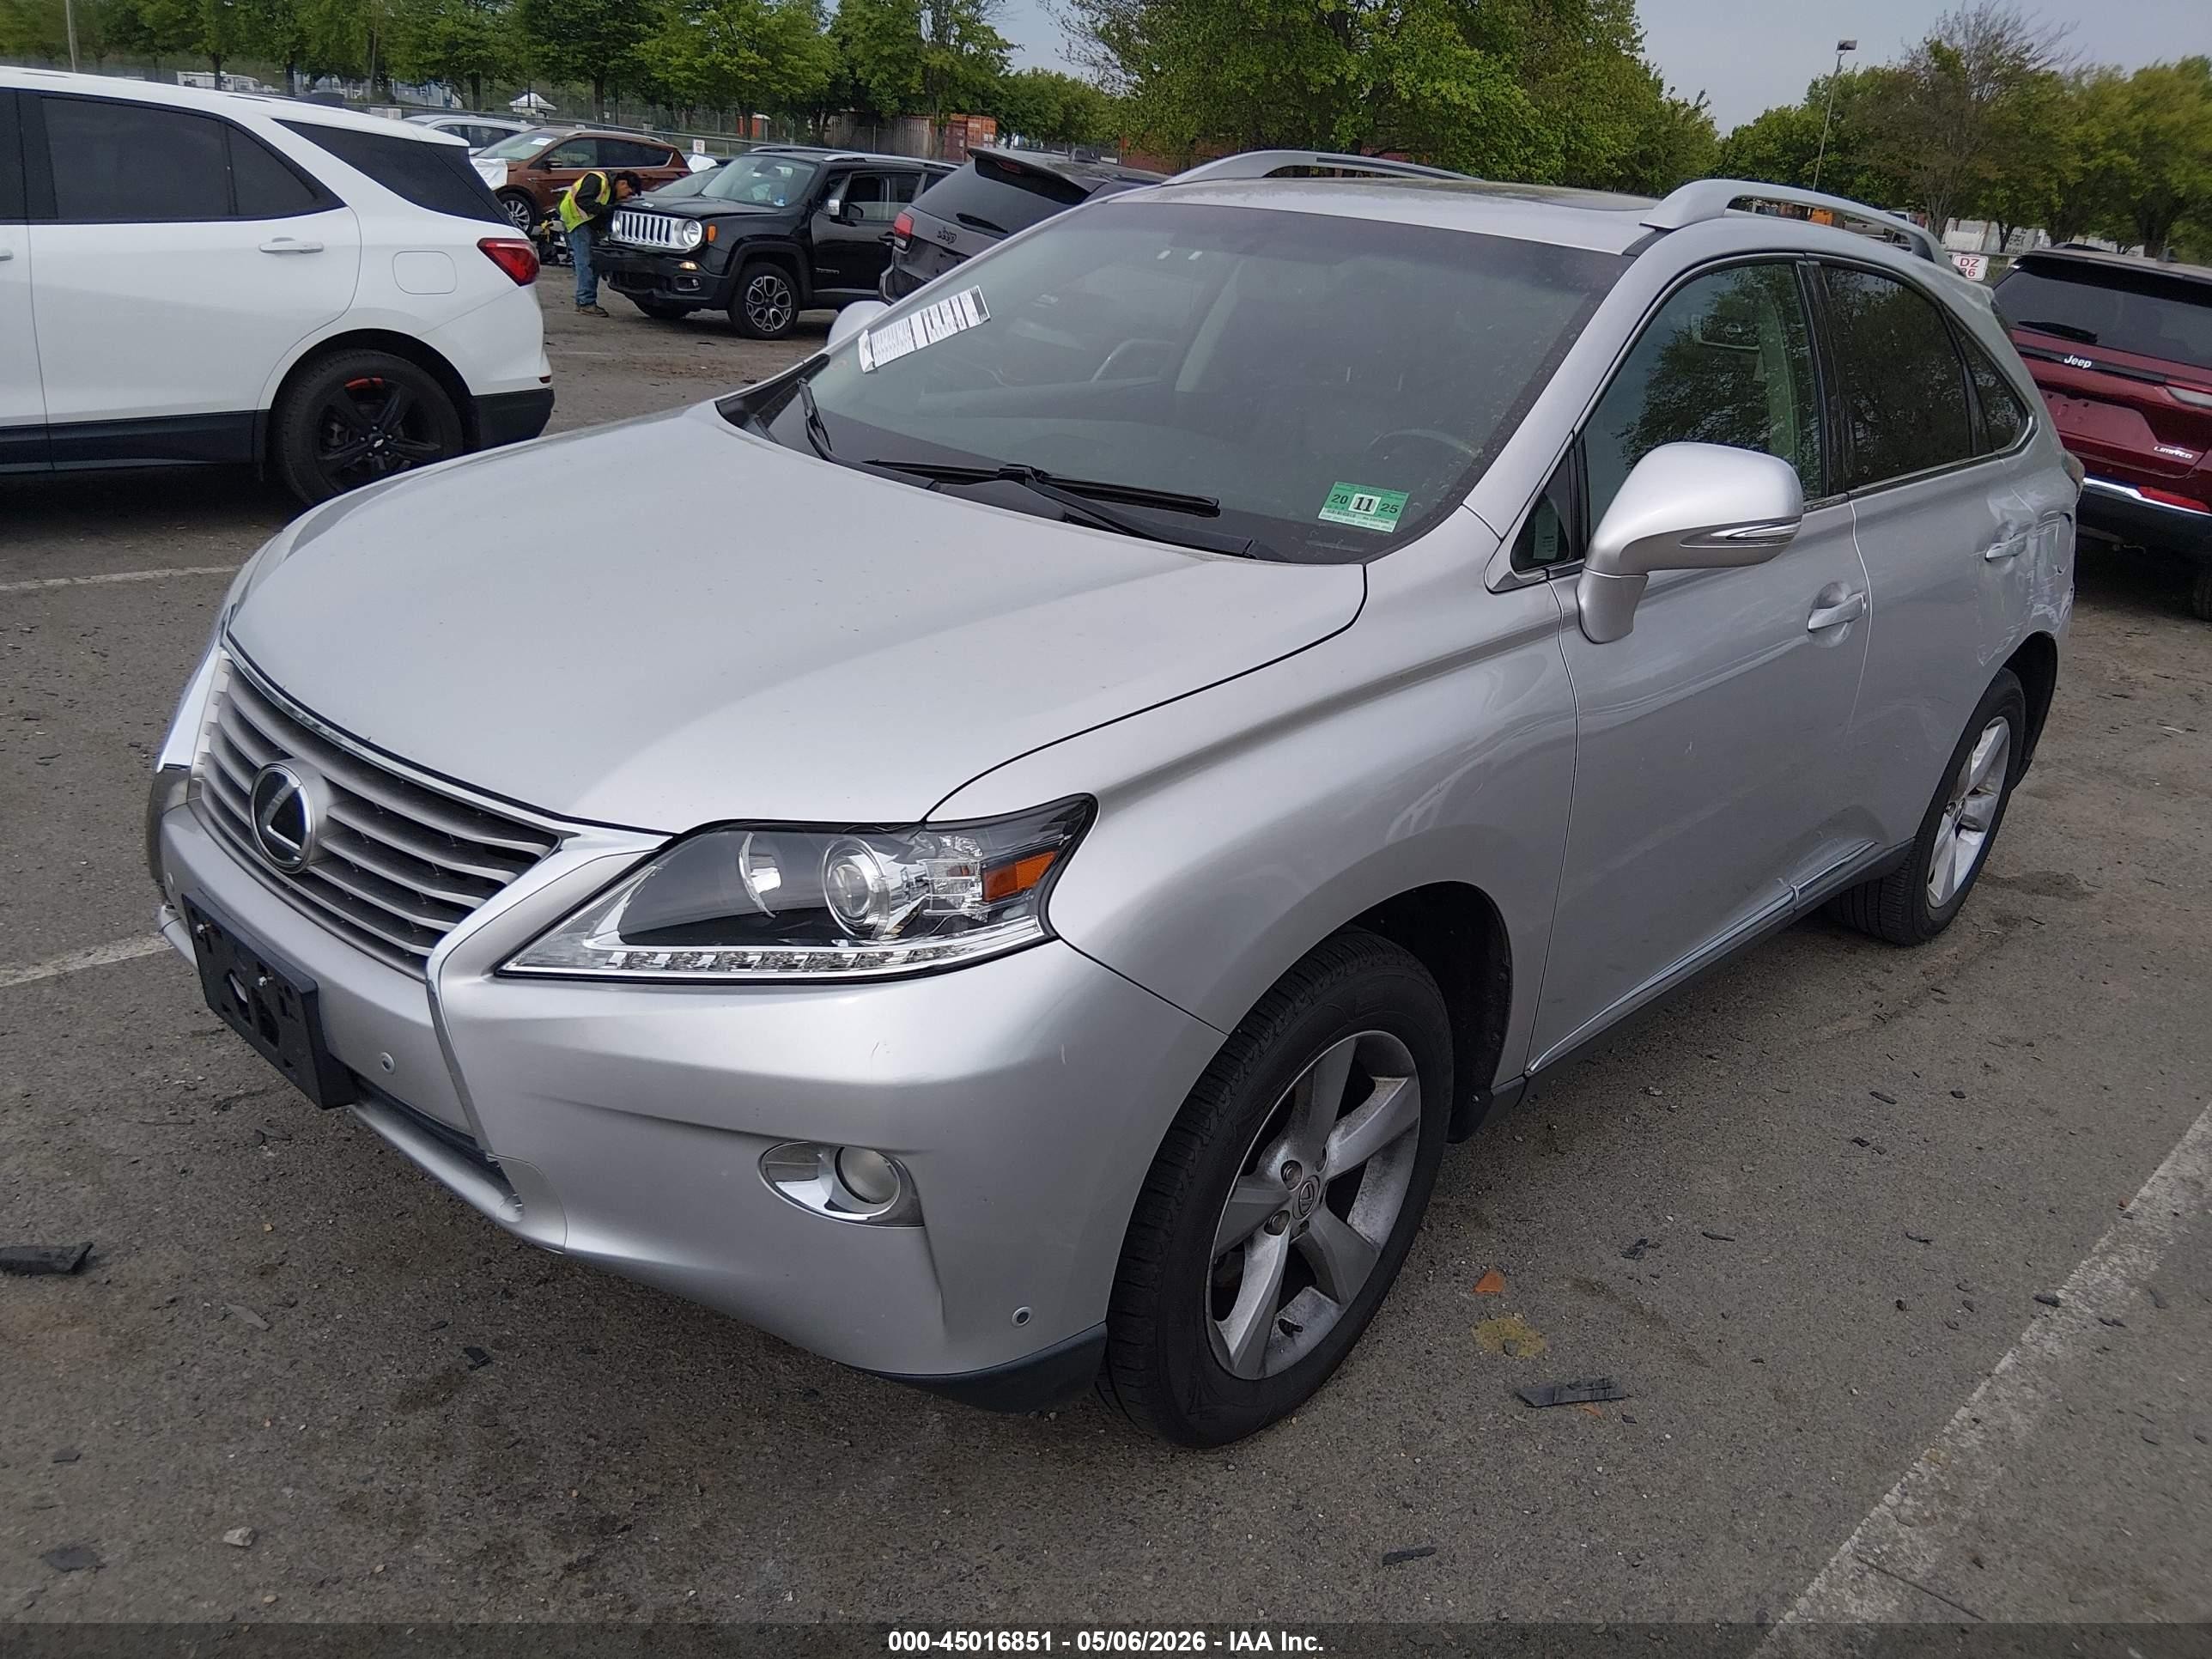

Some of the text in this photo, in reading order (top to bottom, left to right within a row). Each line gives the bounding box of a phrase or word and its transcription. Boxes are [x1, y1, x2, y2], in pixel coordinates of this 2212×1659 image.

[1960, 258, 1979, 268] DZ
[2063, 355, 2093, 369] Jeep
[1331, 494, 1400, 514] 20 11 25
